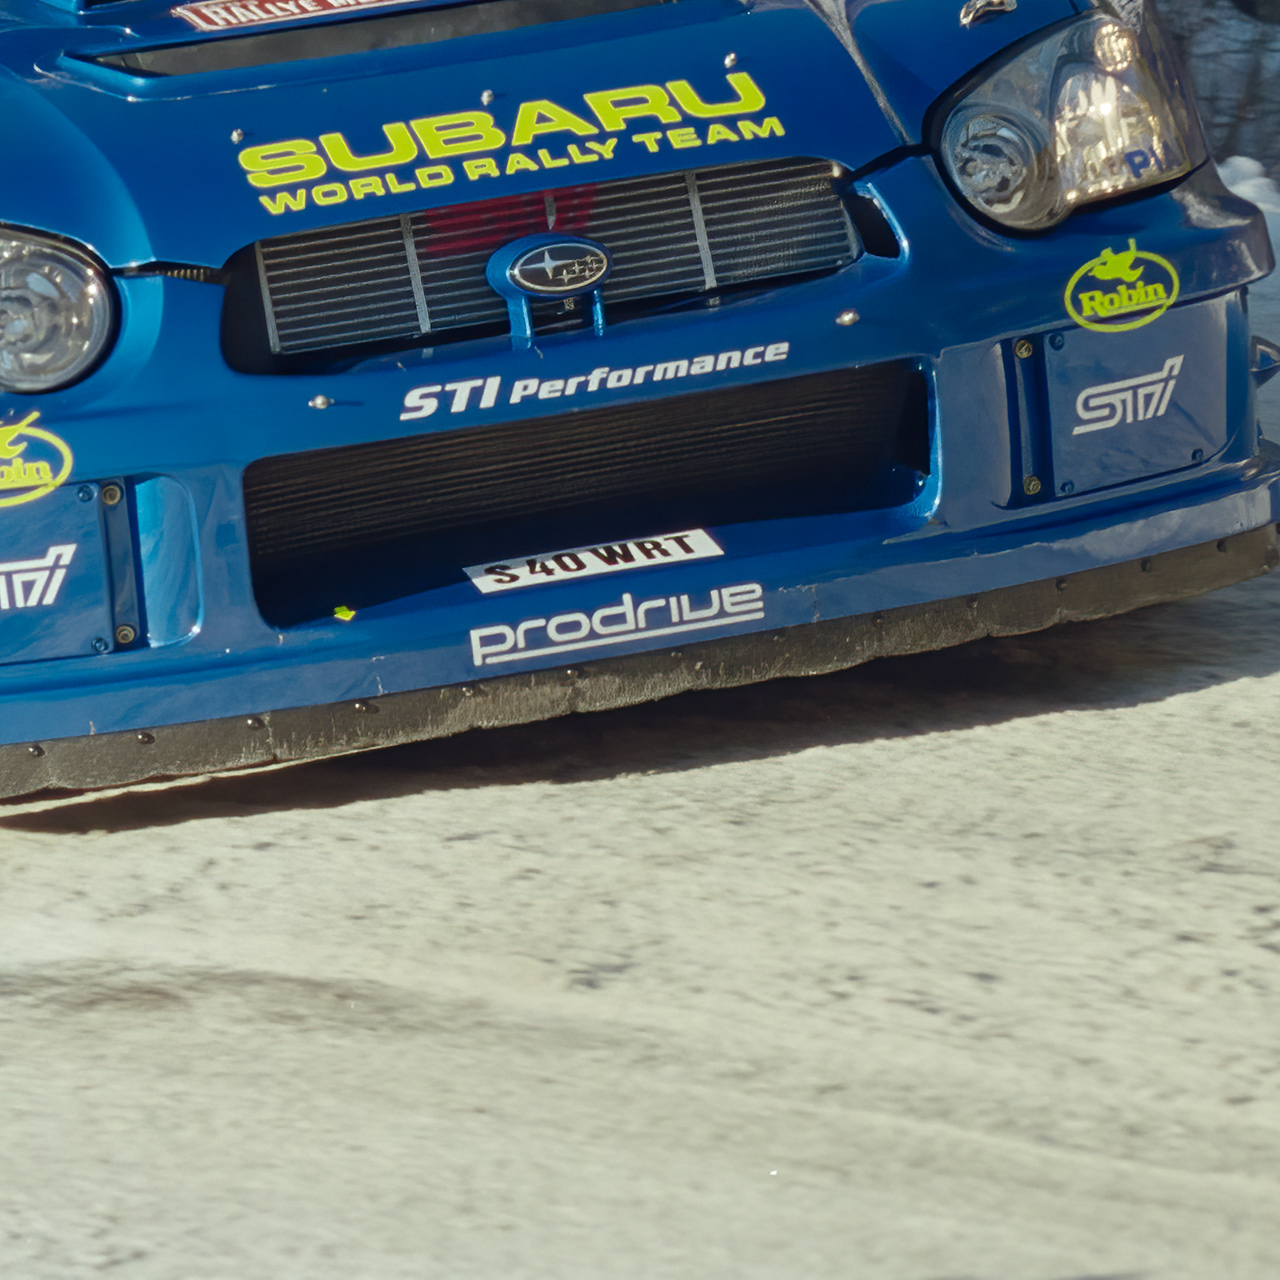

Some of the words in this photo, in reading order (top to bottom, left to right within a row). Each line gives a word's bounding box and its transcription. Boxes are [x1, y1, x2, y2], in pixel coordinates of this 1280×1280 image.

[239, 71, 766, 188] SUBARU
[258, 165, 455, 216] WORLD
[467, 137, 619, 182] RALLY
[631, 116, 786, 154] TEAM
[1079, 279, 1168, 318] Robin
[399, 375, 502, 421] STI
[509, 341, 790, 405] Performance
